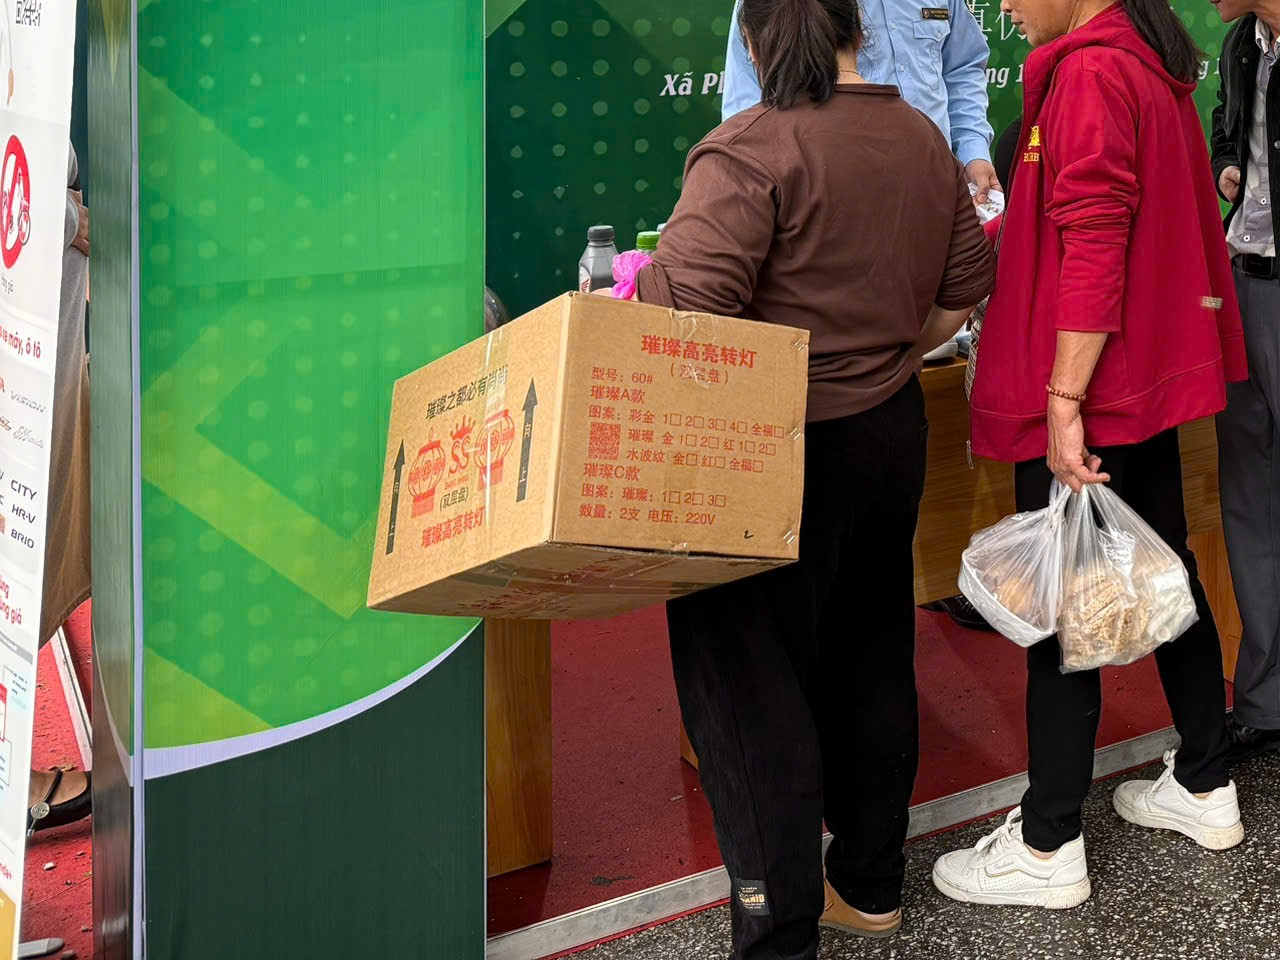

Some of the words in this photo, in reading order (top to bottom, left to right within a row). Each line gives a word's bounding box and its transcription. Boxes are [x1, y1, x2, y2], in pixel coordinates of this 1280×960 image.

[659, 71, 693, 97] Xã
[640, 334, 758, 369] 璀璨高亮转灯
[590, 385, 646, 404] 璀璨A款
[627, 428, 654, 443] 璀璨
[626, 447, 666, 464] 水波纹
[583, 462, 641, 481] 璀璨C款
[11, 479, 37, 500] CITY
[11, 503, 36, 524] HR-V
[11, 528, 35, 549] BRIO
